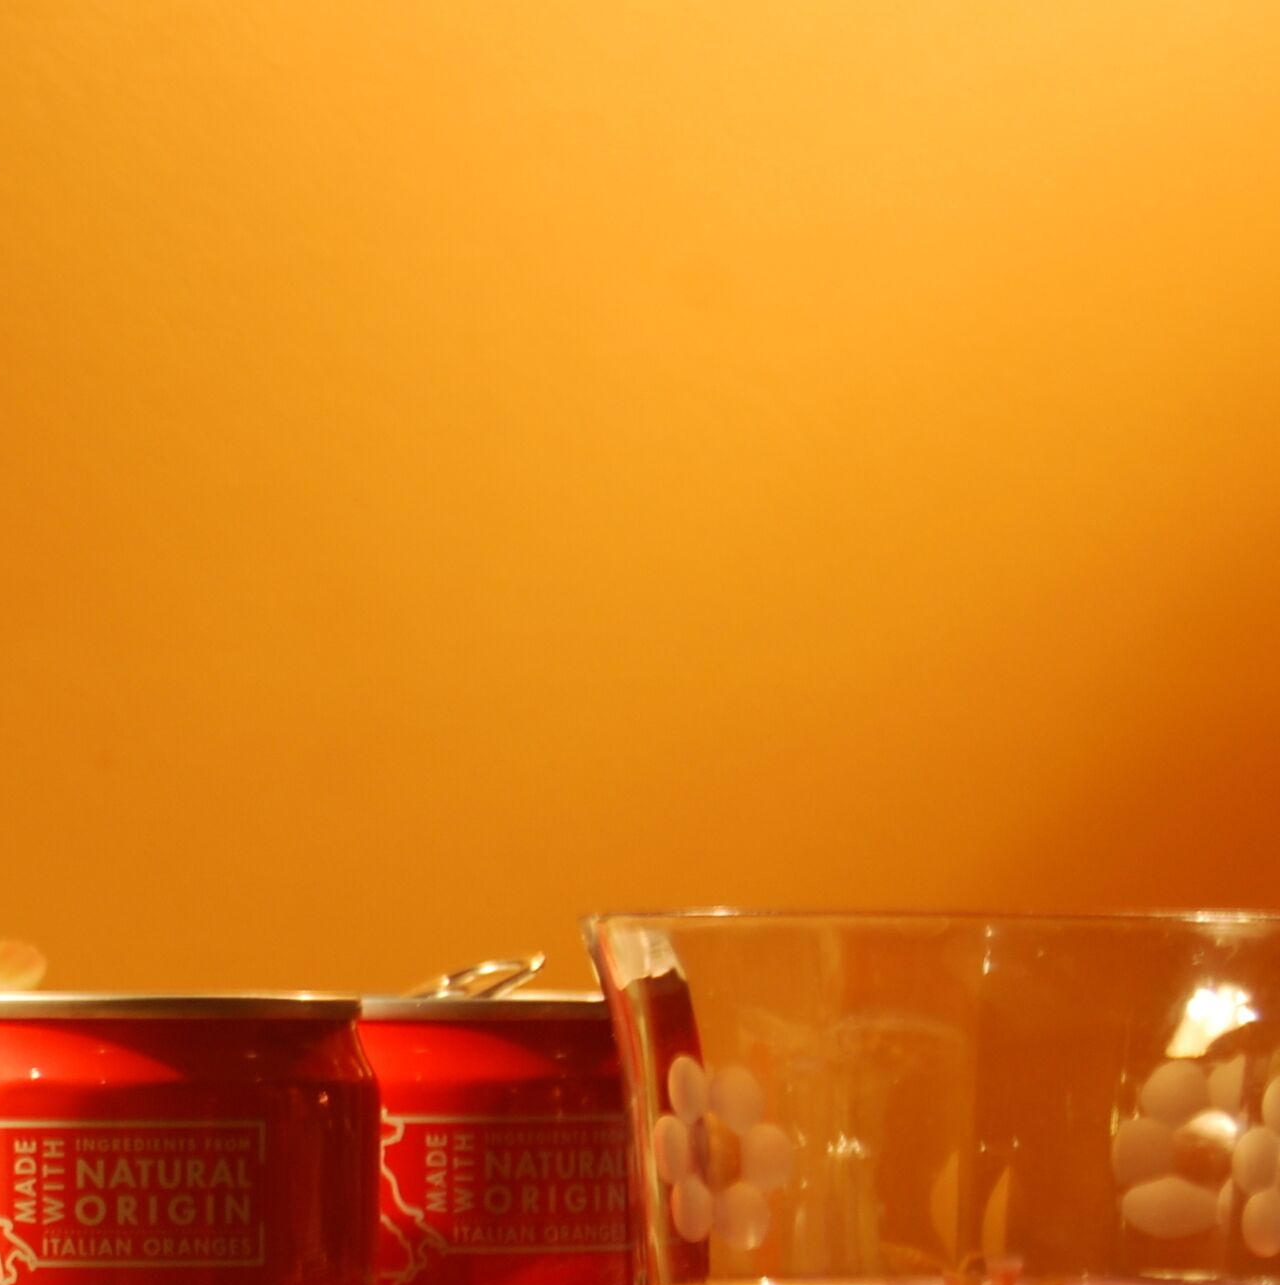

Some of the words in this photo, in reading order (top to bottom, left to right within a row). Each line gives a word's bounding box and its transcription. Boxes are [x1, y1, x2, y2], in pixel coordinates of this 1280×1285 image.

[75, 1138, 196, 1152] INGREDIENTS
[205, 1138, 251, 1152] FROM
[76, 1158, 252, 1189] NATURAL
[426, 1134, 447, 1212] MADE
[454, 1134, 474, 1213] WITH
[484, 1151, 625, 1180] NATURAL
[14, 1139, 36, 1224] MADE
[43, 1139, 64, 1225] WITH
[74, 1195, 251, 1226] ORIGIN
[483, 1184, 625, 1214] ORIGIN
[42, 1237, 132, 1257] ITALIAN
[143, 1237, 251, 1257] ORANGES
[453, 1225, 534, 1243] ITALIAN
